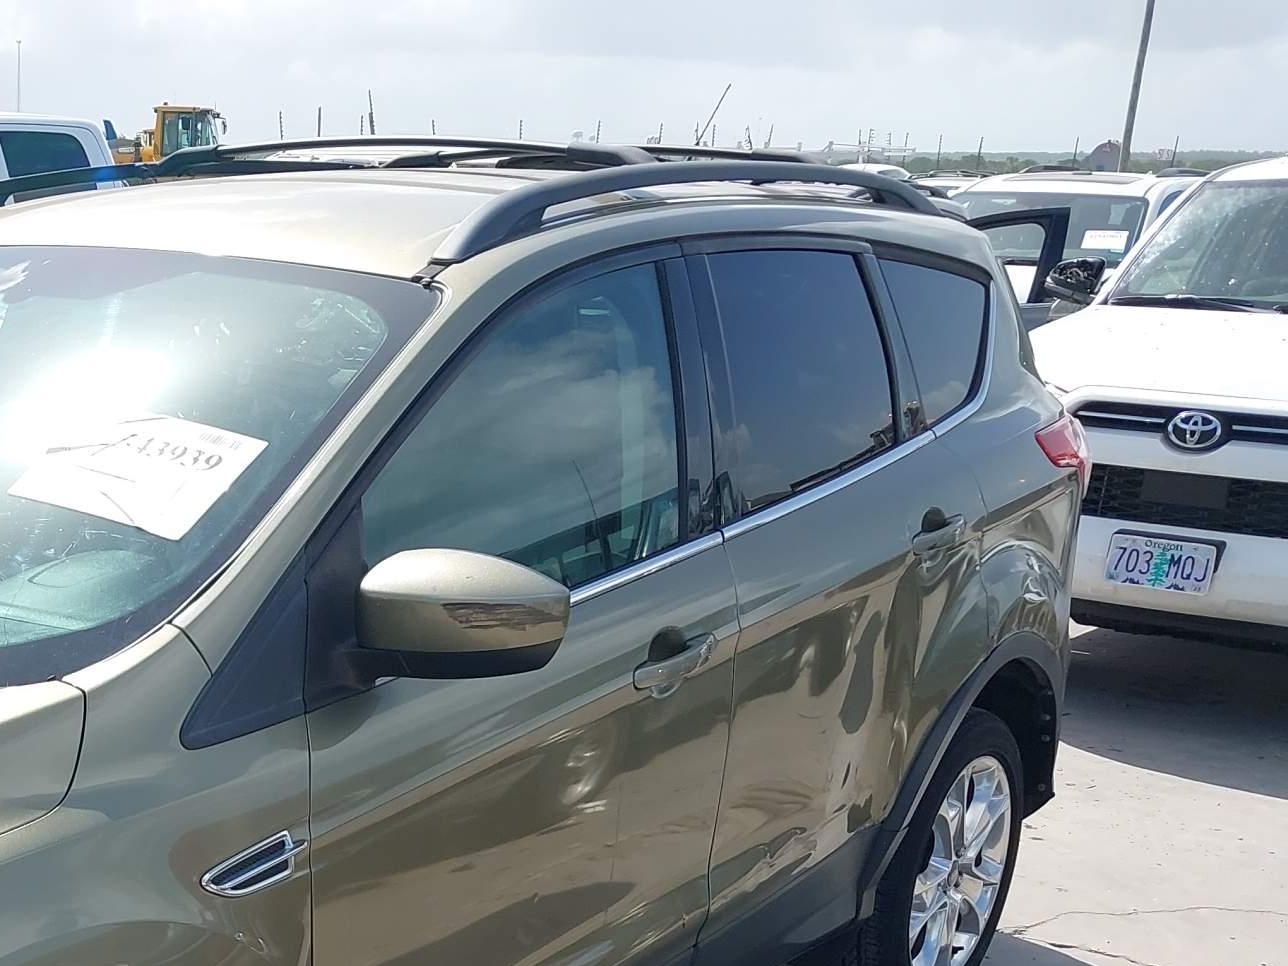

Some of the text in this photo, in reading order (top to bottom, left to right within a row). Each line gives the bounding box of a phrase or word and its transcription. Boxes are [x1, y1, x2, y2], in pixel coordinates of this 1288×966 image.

[1144, 539, 1183, 553] Oregon
[1114, 546, 1210, 583] 703 MQJ
